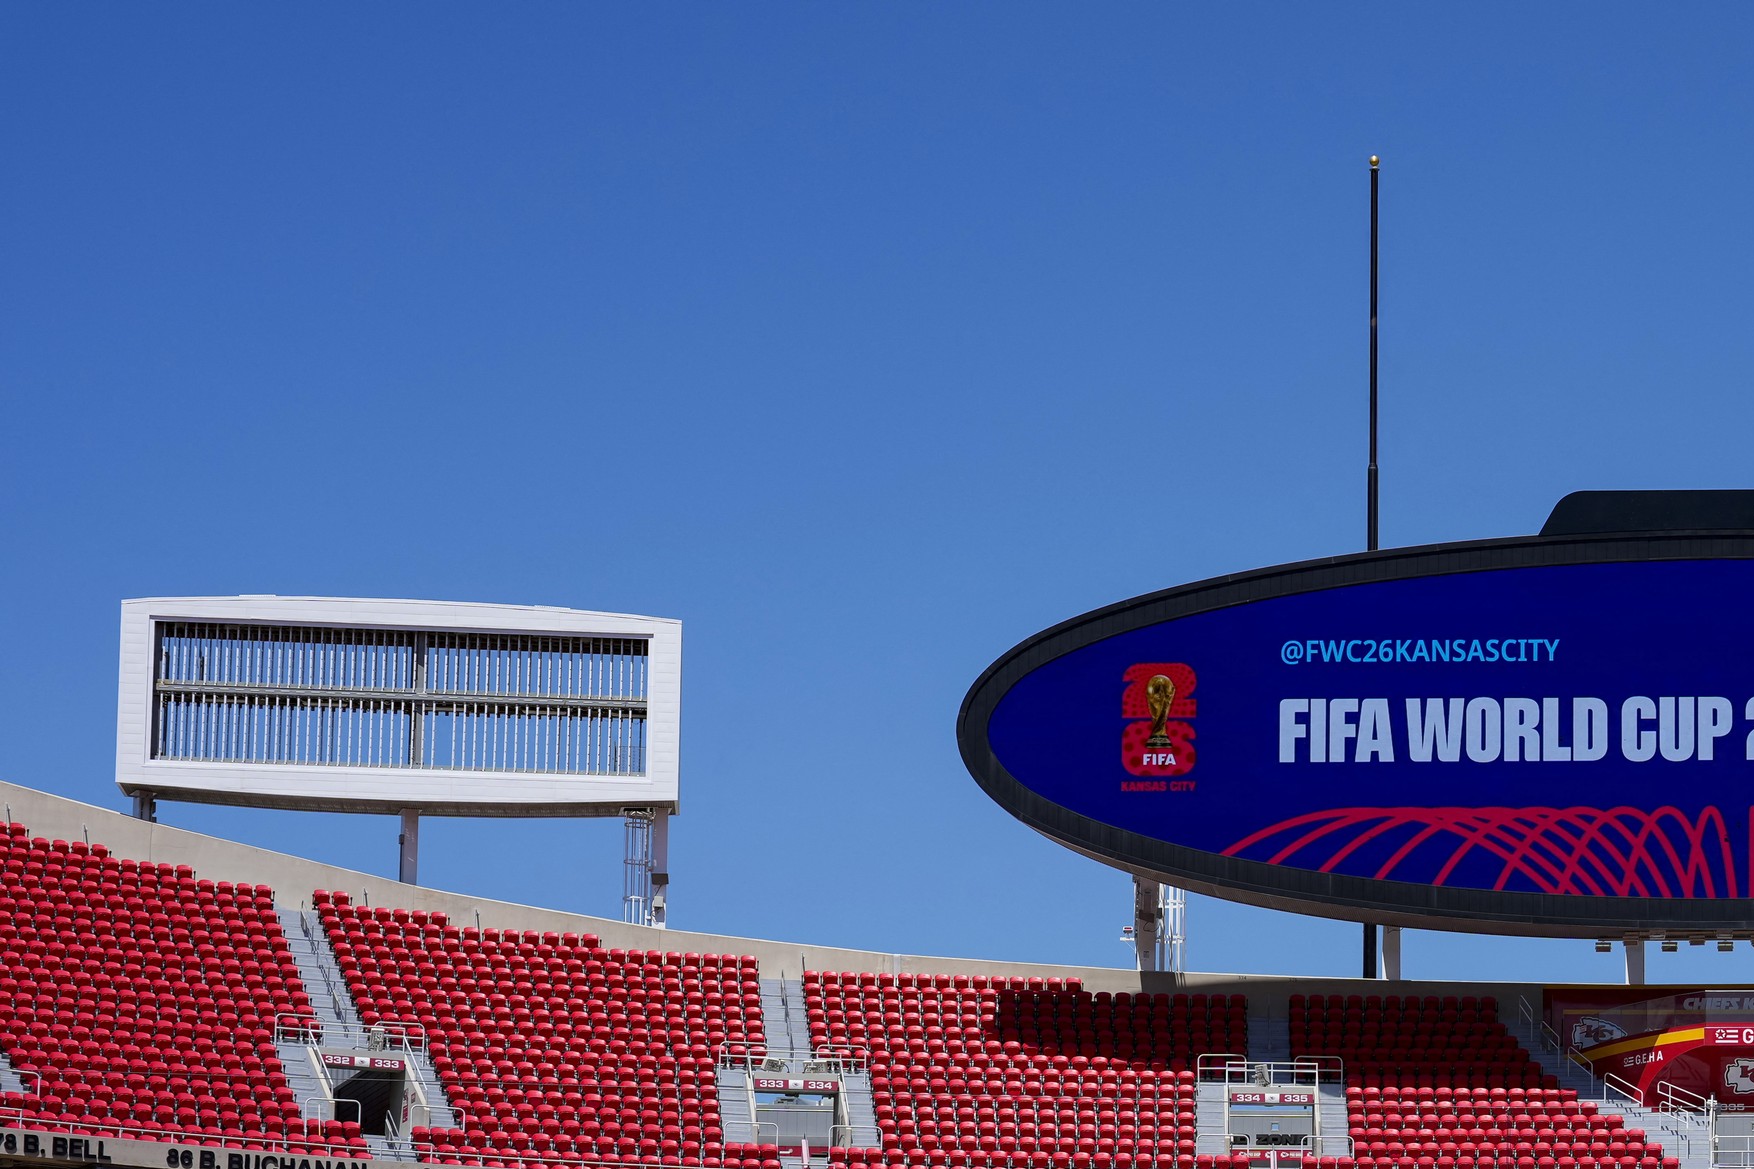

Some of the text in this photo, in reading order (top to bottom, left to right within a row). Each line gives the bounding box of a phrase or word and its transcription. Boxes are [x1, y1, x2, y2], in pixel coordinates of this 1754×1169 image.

[1280, 638, 1560, 665] @FWC26KANSASCITY
[1278, 698, 1395, 763] FIFA
[1405, 697, 1609, 762] WORLD
[1621, 696, 1733, 762] CUP
[1143, 753, 1176, 765] FIFA
[1121, 781, 1196, 792] KANSAS CITY
[1683, 997, 1741, 1010] CHIEFS
[325, 1056, 399, 1069] 332 333
[1635, 1051, 1664, 1065] G.E.HA
[760, 1080, 832, 1090] 333 334
[1236, 1094, 1308, 1102] 334 335
[0, 1133, 111, 1161] 8 B. BELL
[166, 1148, 193, 1169] 86
